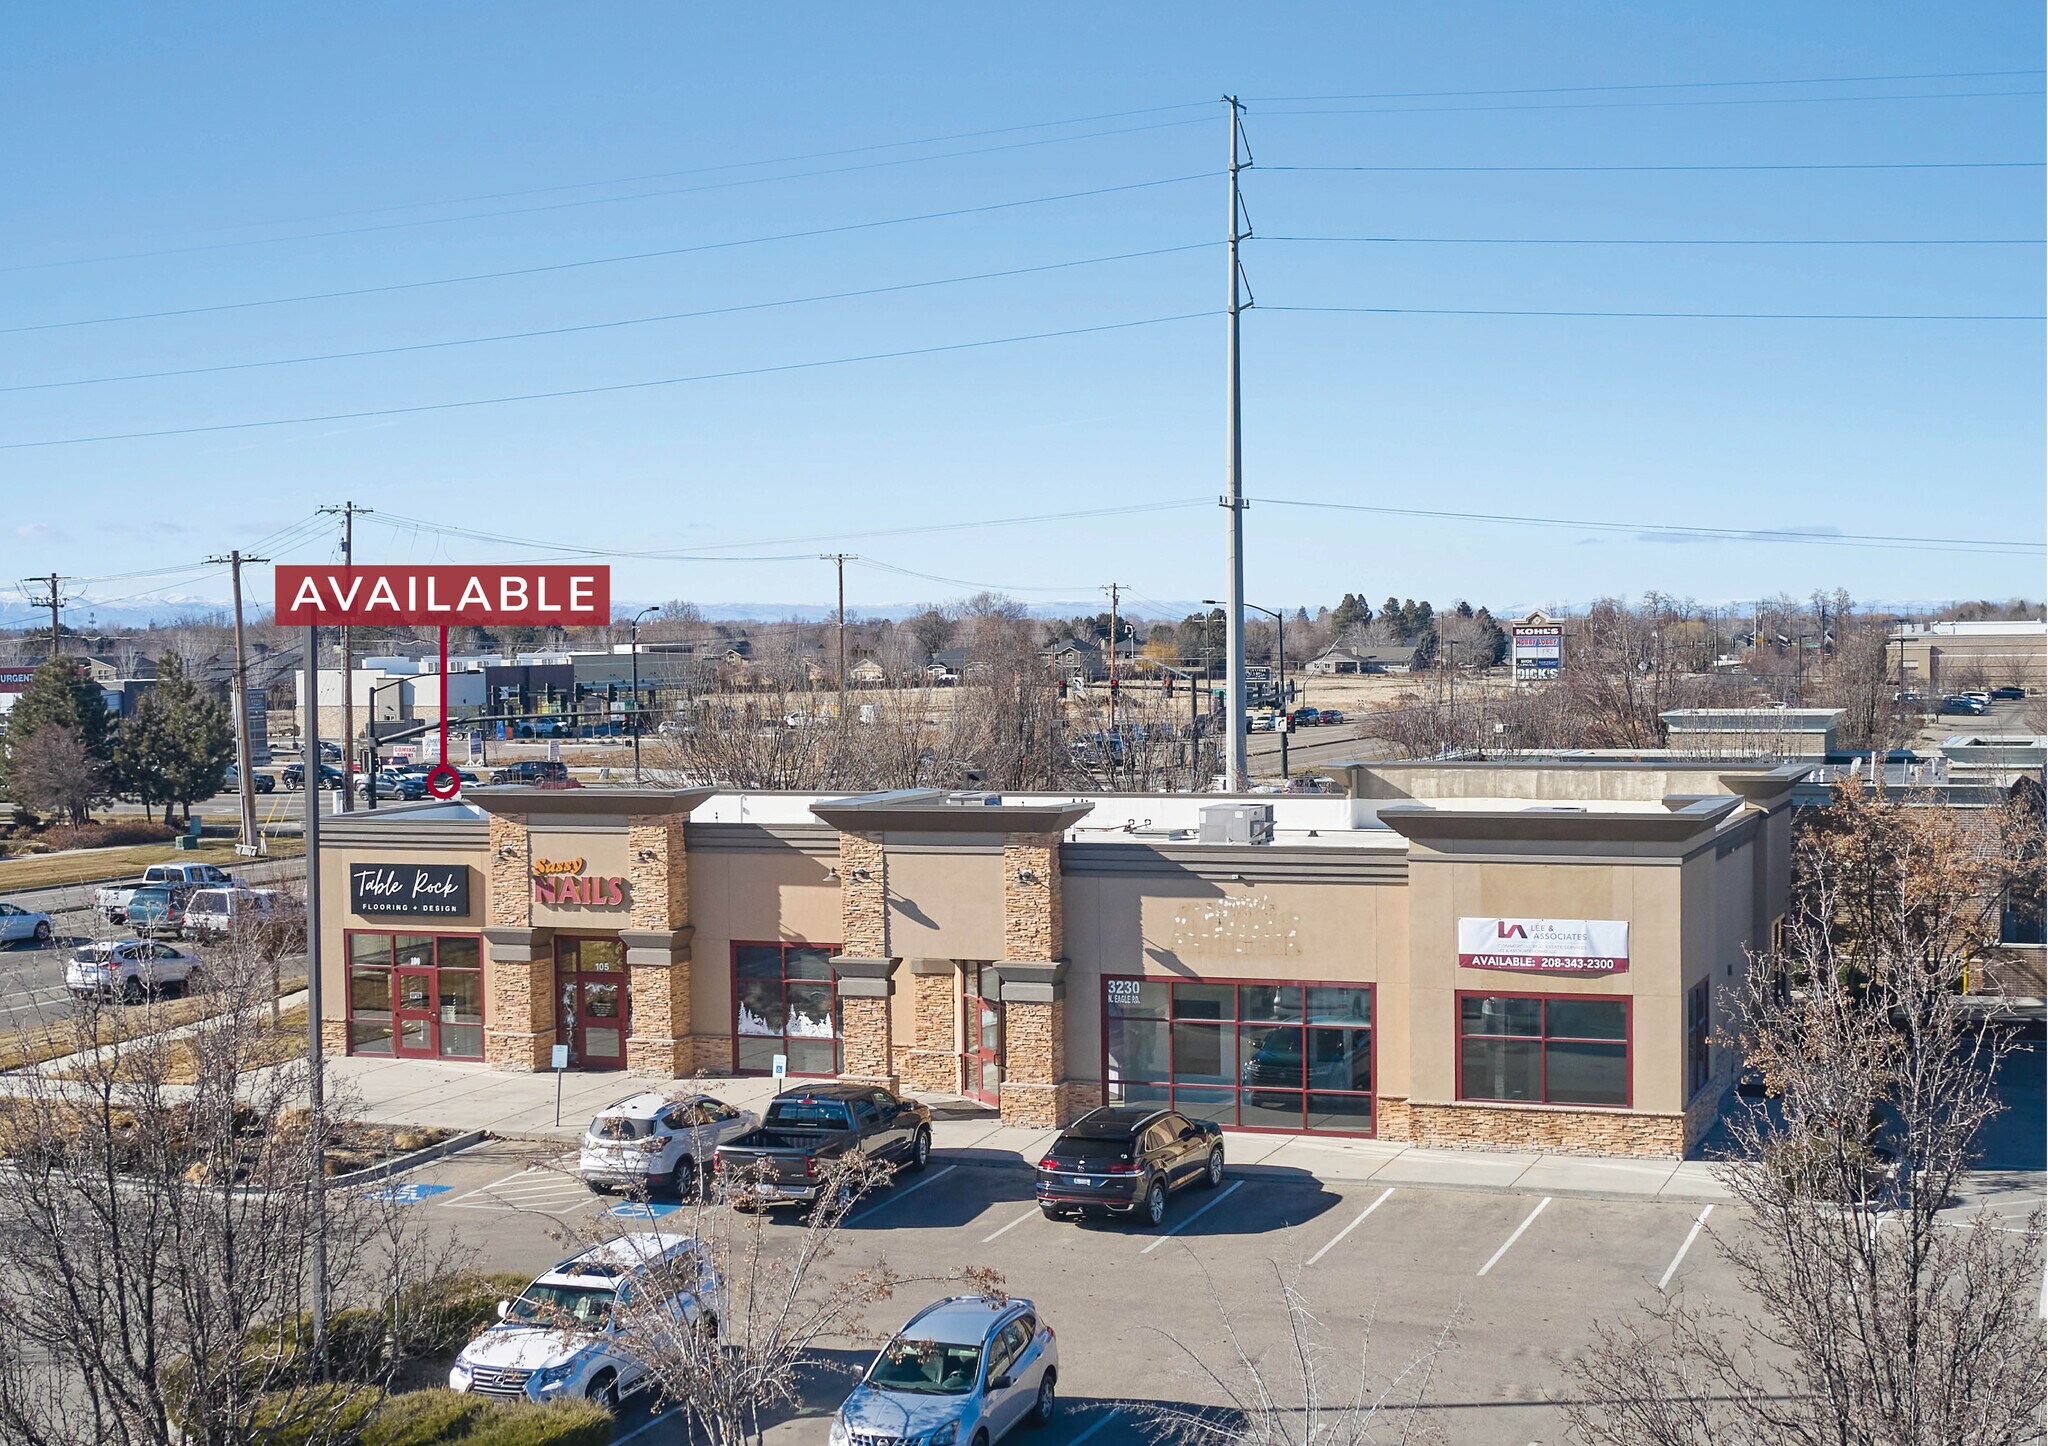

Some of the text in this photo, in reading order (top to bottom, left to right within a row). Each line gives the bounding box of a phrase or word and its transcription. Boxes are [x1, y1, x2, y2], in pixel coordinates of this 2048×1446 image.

[0, 673, 35, 683] URGENT
[1516, 668, 1559, 680] DICK'S
[532, 857, 583, 875] Sassy
[353, 868, 459, 899] Table Rock
[533, 875, 623, 905] NAILS
[362, 903, 408, 911] FLOORING
[1530, 924, 1545, 932] LEE
[1533, 932, 1588, 941] ASSOCIATES
[595, 962, 610, 971] 105
[1471, 955, 1614, 969] AVAILABLE: 208-343-2300
[1107, 980, 1140, 994] 3230
[1114, 994, 1131, 1004] EAGLE
